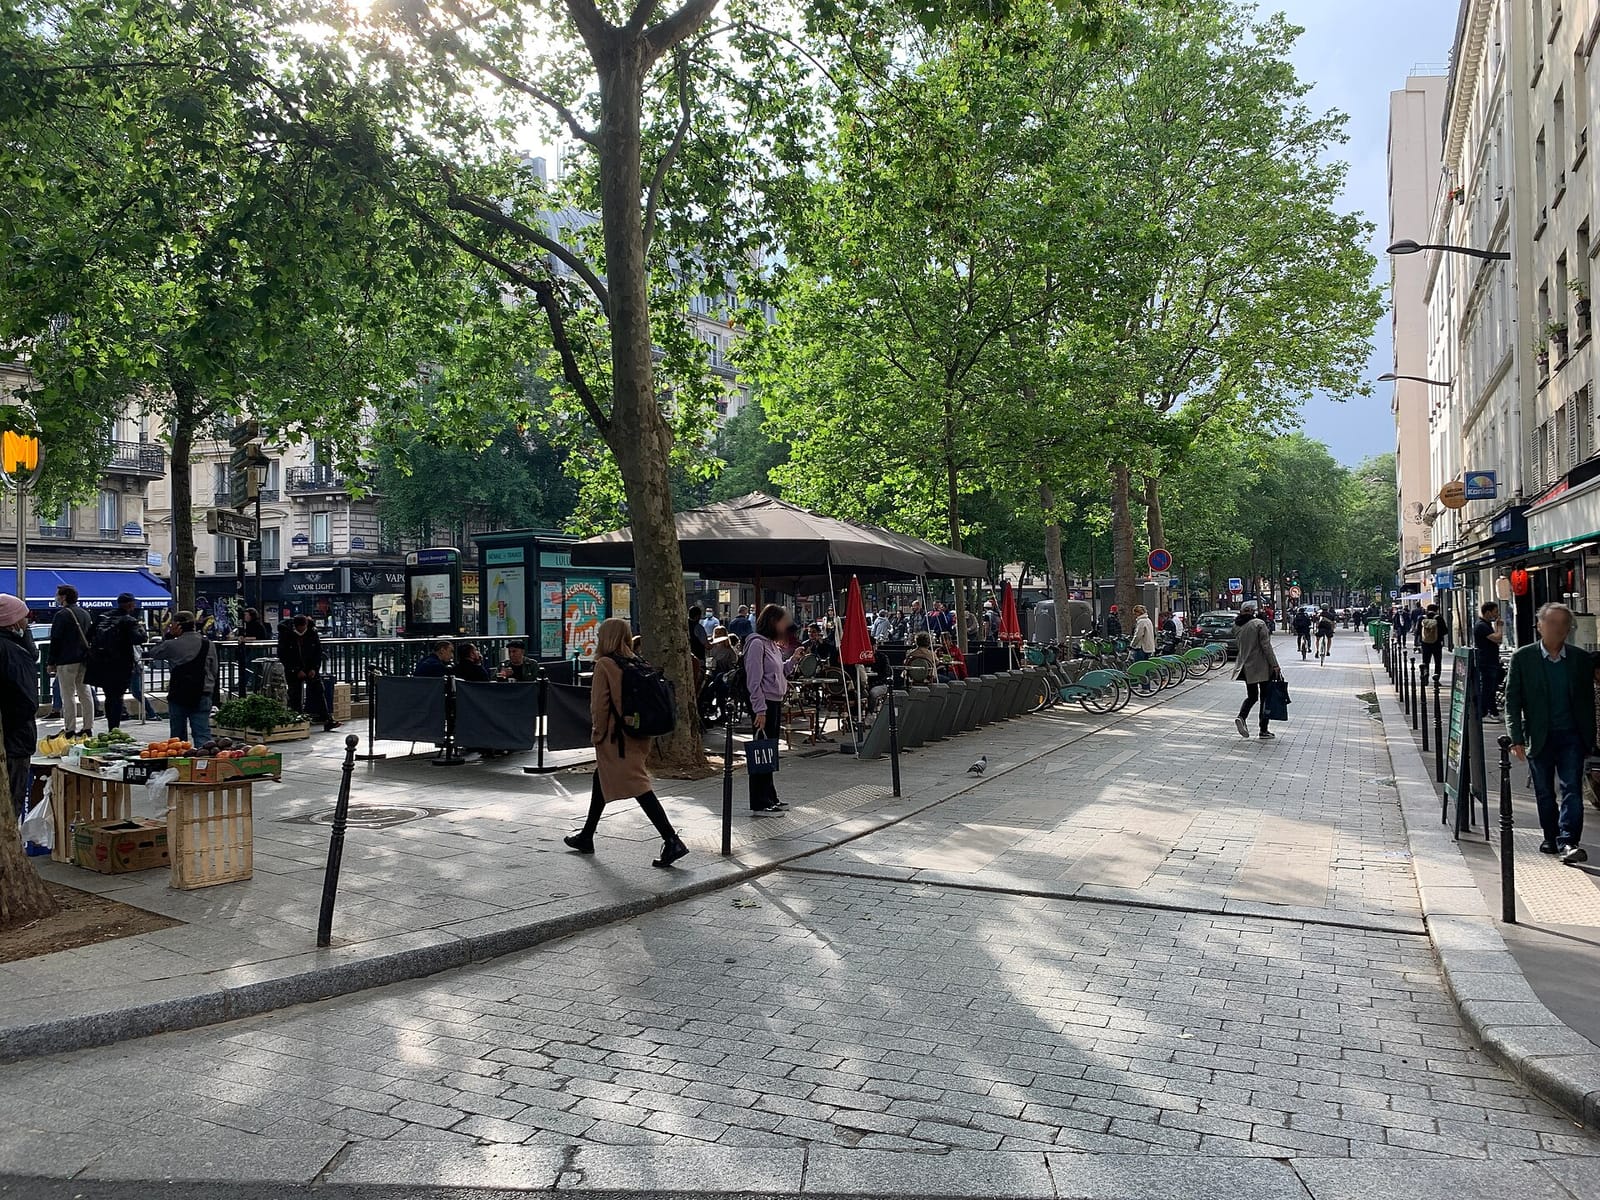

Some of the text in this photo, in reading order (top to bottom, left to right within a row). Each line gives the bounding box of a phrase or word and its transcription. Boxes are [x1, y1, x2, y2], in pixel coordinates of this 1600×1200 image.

[889, 585, 921, 594] PHARMAIE
[583, 600, 598, 615] LA
[754, 748, 773, 765] GAP
